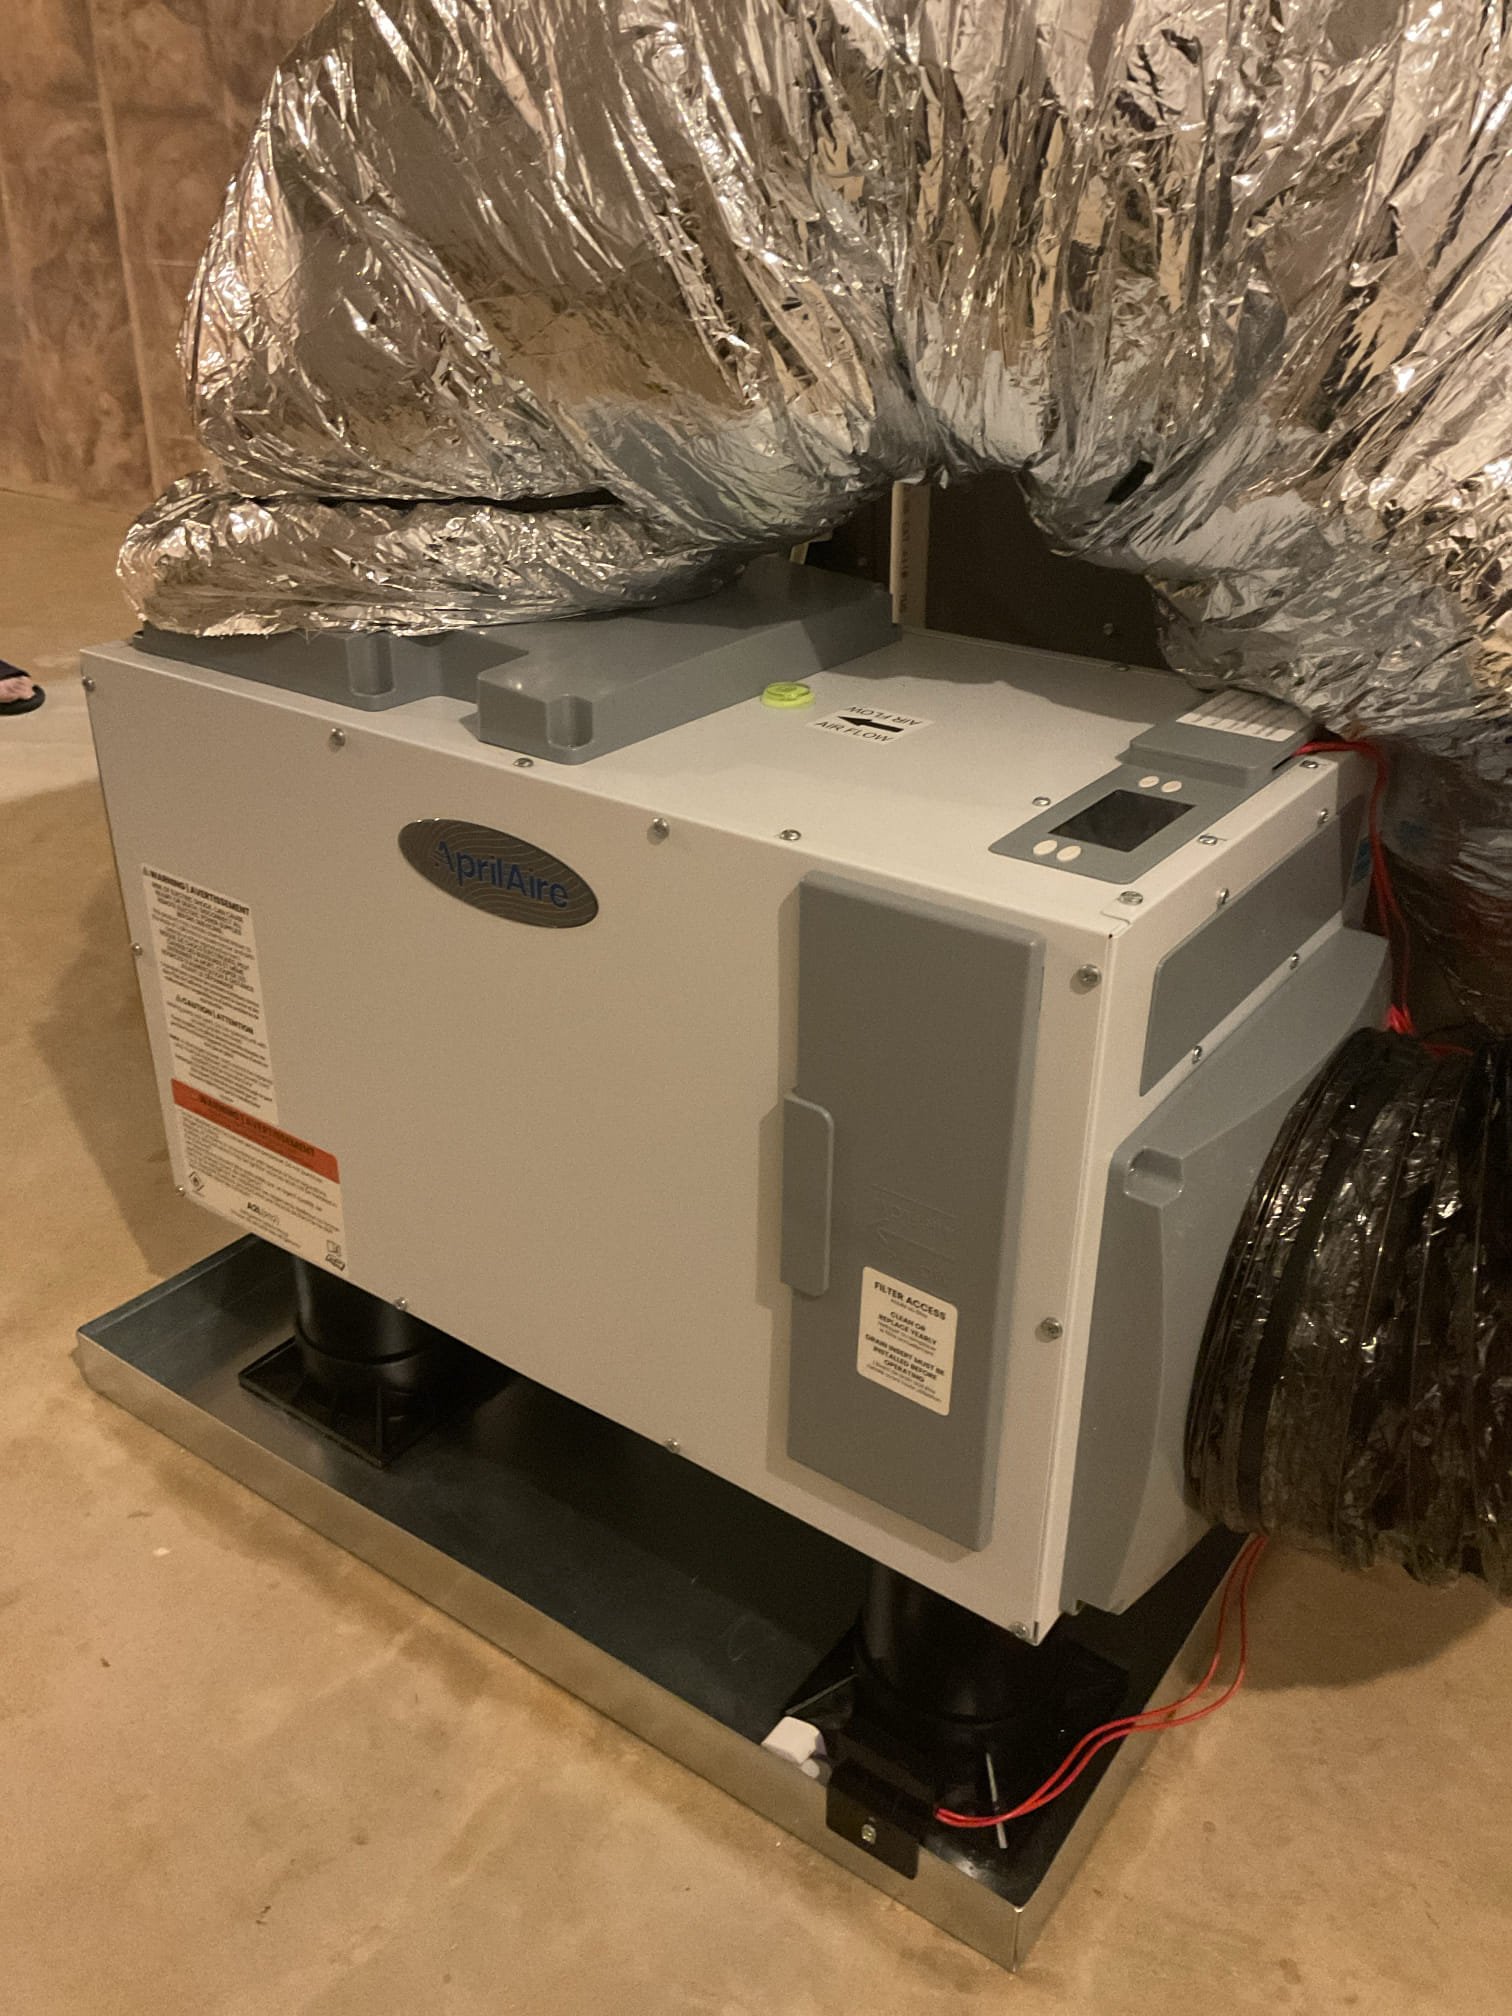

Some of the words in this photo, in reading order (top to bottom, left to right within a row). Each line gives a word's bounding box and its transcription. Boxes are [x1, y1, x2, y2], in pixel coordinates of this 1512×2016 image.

[847, 706, 892, 720] FLOW
[892, 715, 922, 726] AIR
[815, 721, 843, 731] AIR
[844, 727, 895, 742] FLOW
[431, 841, 568, 908] AprilAire
[874, 1281, 904, 1301] FILTER
[906, 1296, 946, 1321] ACCESS
[878, 1313, 909, 1333] REPLACE
[910, 1329, 937, 1345] YEARLY
[890, 1311, 914, 1327] CLEAN
[915, 1322, 926, 1332] OR
